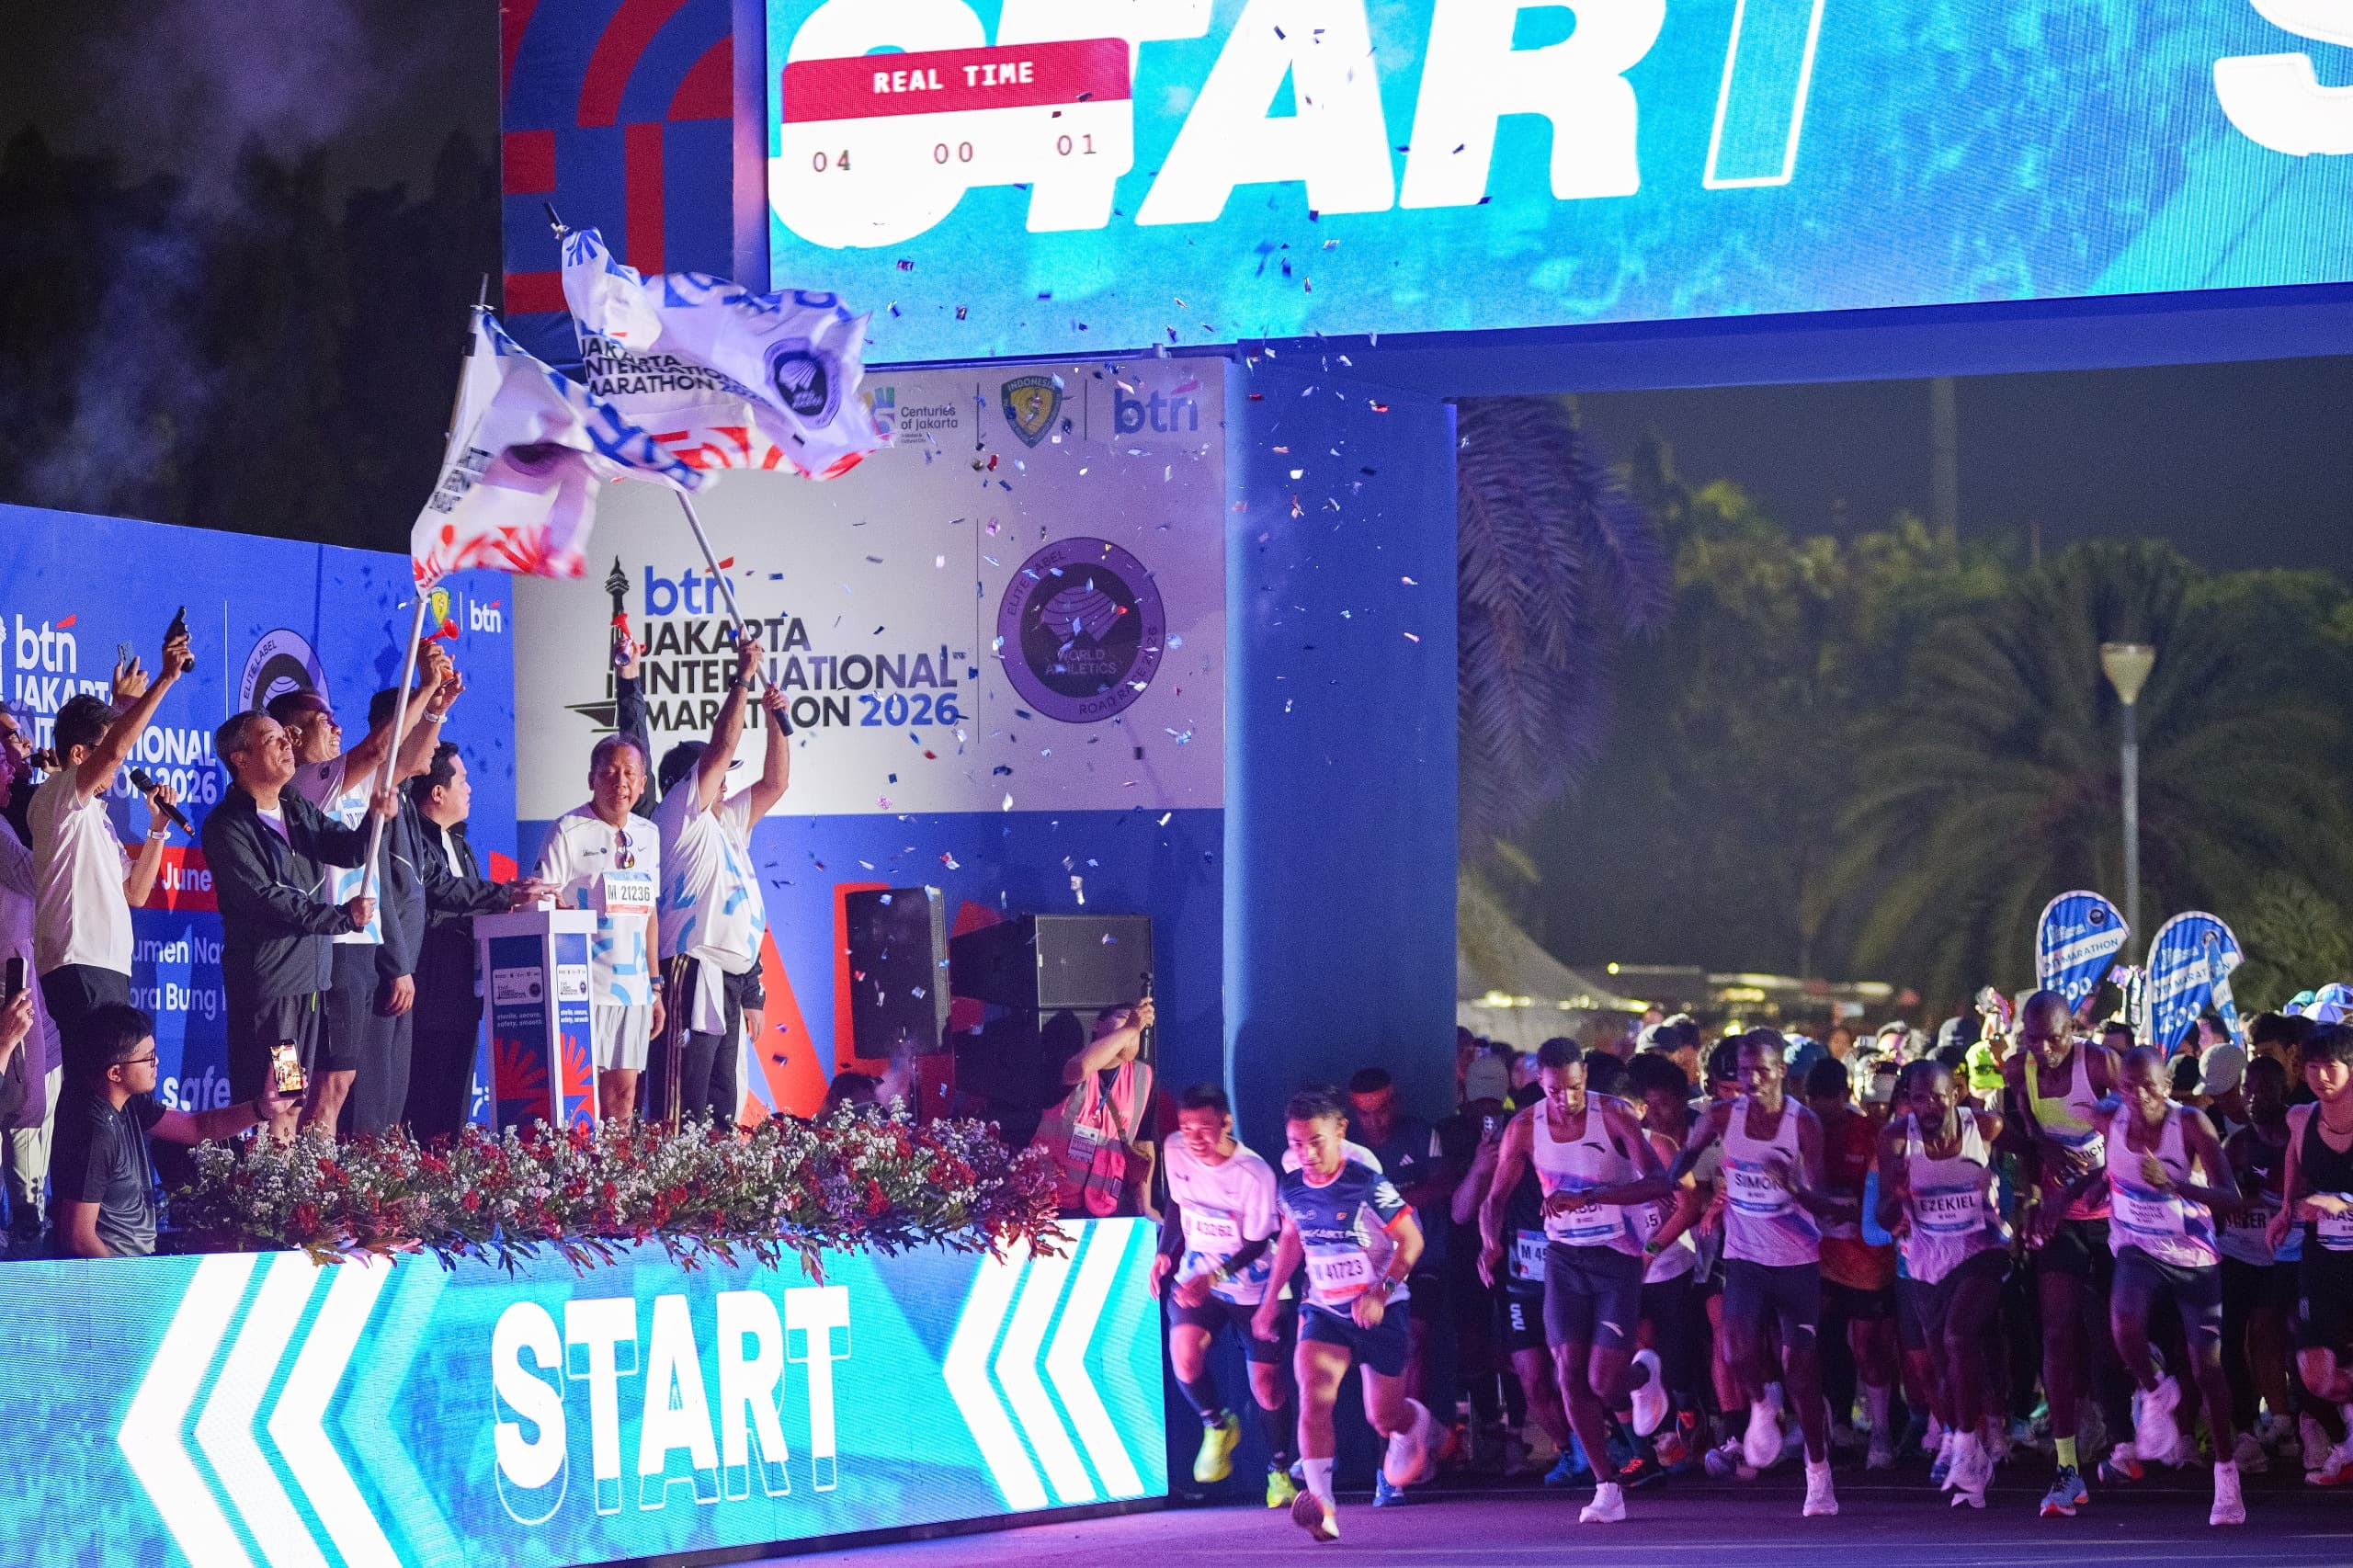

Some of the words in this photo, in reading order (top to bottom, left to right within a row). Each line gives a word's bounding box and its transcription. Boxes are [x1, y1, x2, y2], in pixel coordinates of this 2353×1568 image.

[874, 69, 943, 94] REAL
[963, 62, 1034, 87] TIME
[813, 150, 852, 173] 04
[933, 142, 974, 164] 00
[1057, 133, 1097, 156] 01
[1007, 378, 1055, 390] INDONESI
[901, 404, 956, 417] Centuries
[1114, 381, 1199, 434] btn
[901, 418, 912, 430] of
[915, 417, 958, 431] Jakarta
[644, 557, 734, 617] btn
[1007, 579, 1029, 615] ELITE
[471, 599, 502, 633] btn
[16, 614, 76, 674] btn
[642, 618, 812, 657] JAKARTA
[244, 664, 258, 699] ELITE
[256, 640, 278, 665] LABEL
[1046, 663, 1118, 675] AHLETICS
[10, 674, 113, 714] JAKAT
[1079, 697, 1117, 714] ROAD
[645, 696, 850, 731] MARTON
[858, 692, 960, 726] 2026
[162, 862, 212, 892] June
[621, 885, 651, 902] 21236
[133, 939, 189, 964] umen
[194, 937, 224, 964] Na
[2062, 938, 2119, 963] MARATHON
[2174, 963, 2231, 986] MARATN
[130, 986, 161, 1011] ora
[165, 983, 217, 1021] Bung
[1920, 1195, 1976, 1211] EZEKIEL
[1521, 1244, 1531, 1260] M
[491, 1285, 861, 1491] START
